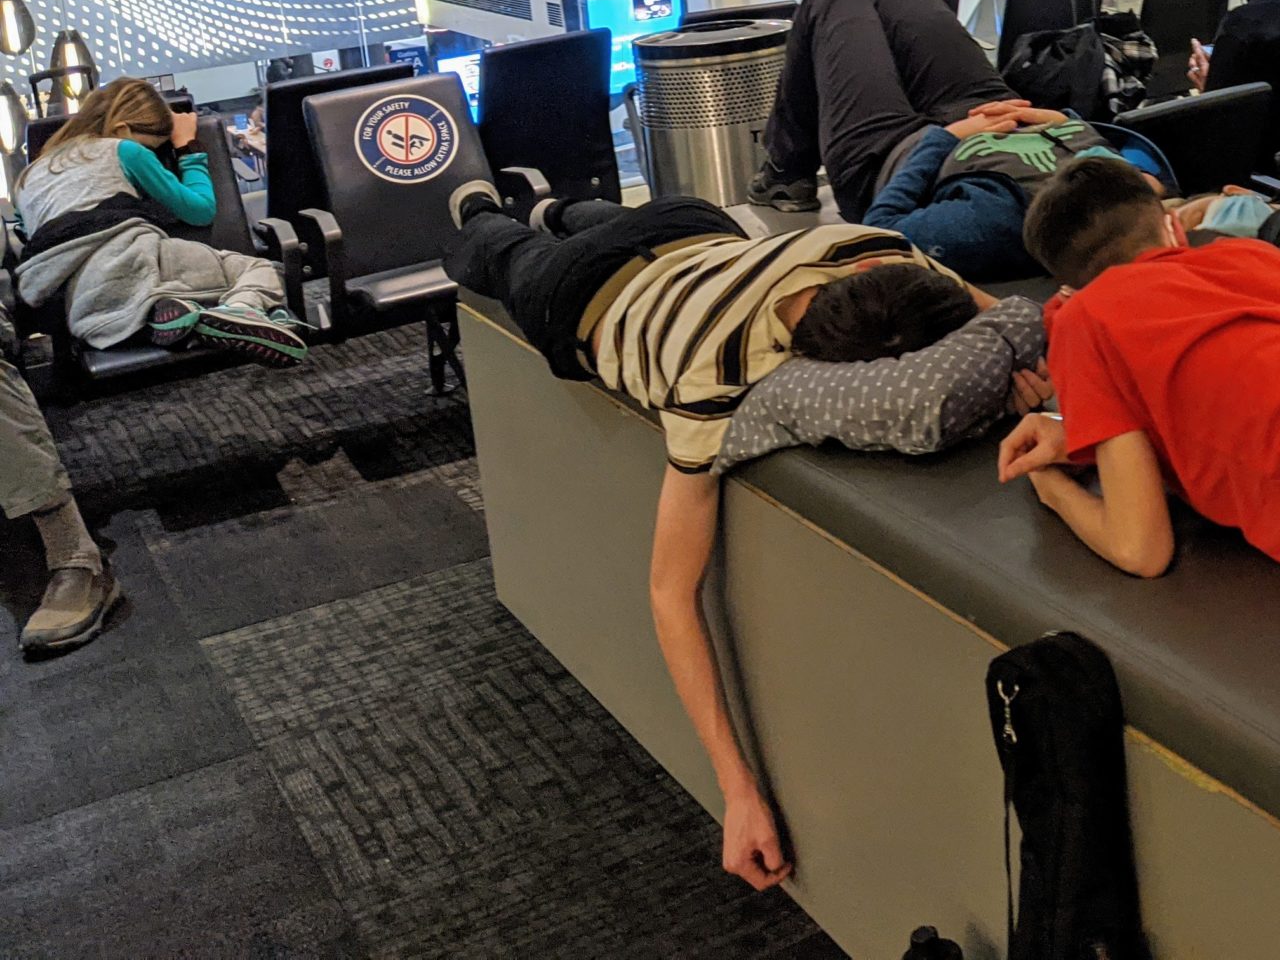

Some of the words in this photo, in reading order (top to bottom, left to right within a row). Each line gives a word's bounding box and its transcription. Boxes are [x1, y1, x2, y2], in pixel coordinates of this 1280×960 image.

[363, 126, 373, 141] FOR
[368, 111, 386, 127] YOUR
[382, 101, 410, 114] SAFETY
[437, 120, 451, 141] SPACE
[434, 142, 450, 163] EXTRA
[384, 165, 413, 177] PLEASE
[413, 160, 438, 176] ALLOW
